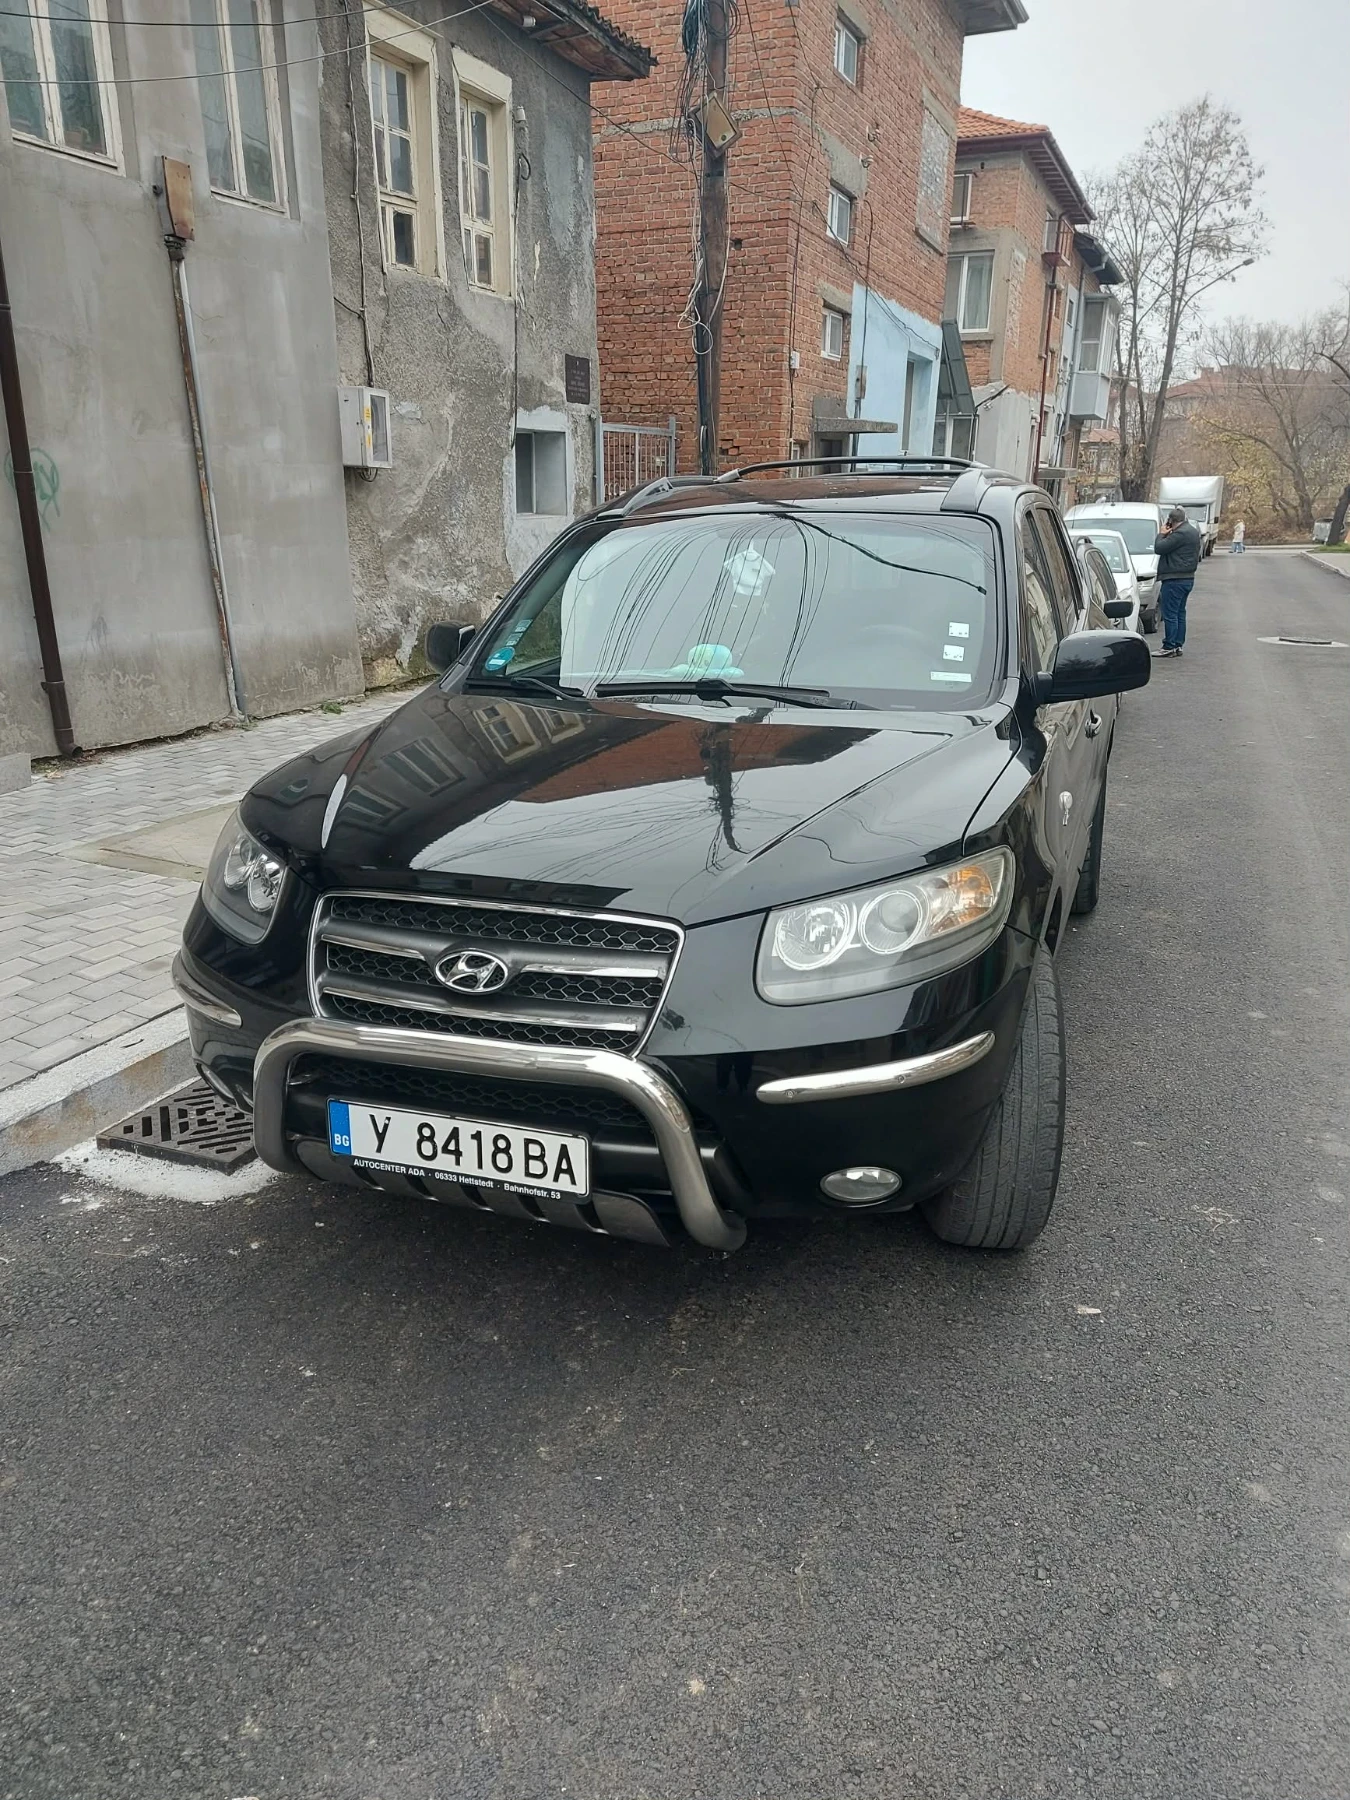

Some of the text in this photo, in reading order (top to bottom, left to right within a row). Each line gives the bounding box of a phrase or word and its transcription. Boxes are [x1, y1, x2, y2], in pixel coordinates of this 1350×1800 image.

[334, 1133, 350, 1147] BG
[353, 1158, 561, 1200] AUTOCENTER ADA 06333 Hettstedt Bahnhofstr. 53
